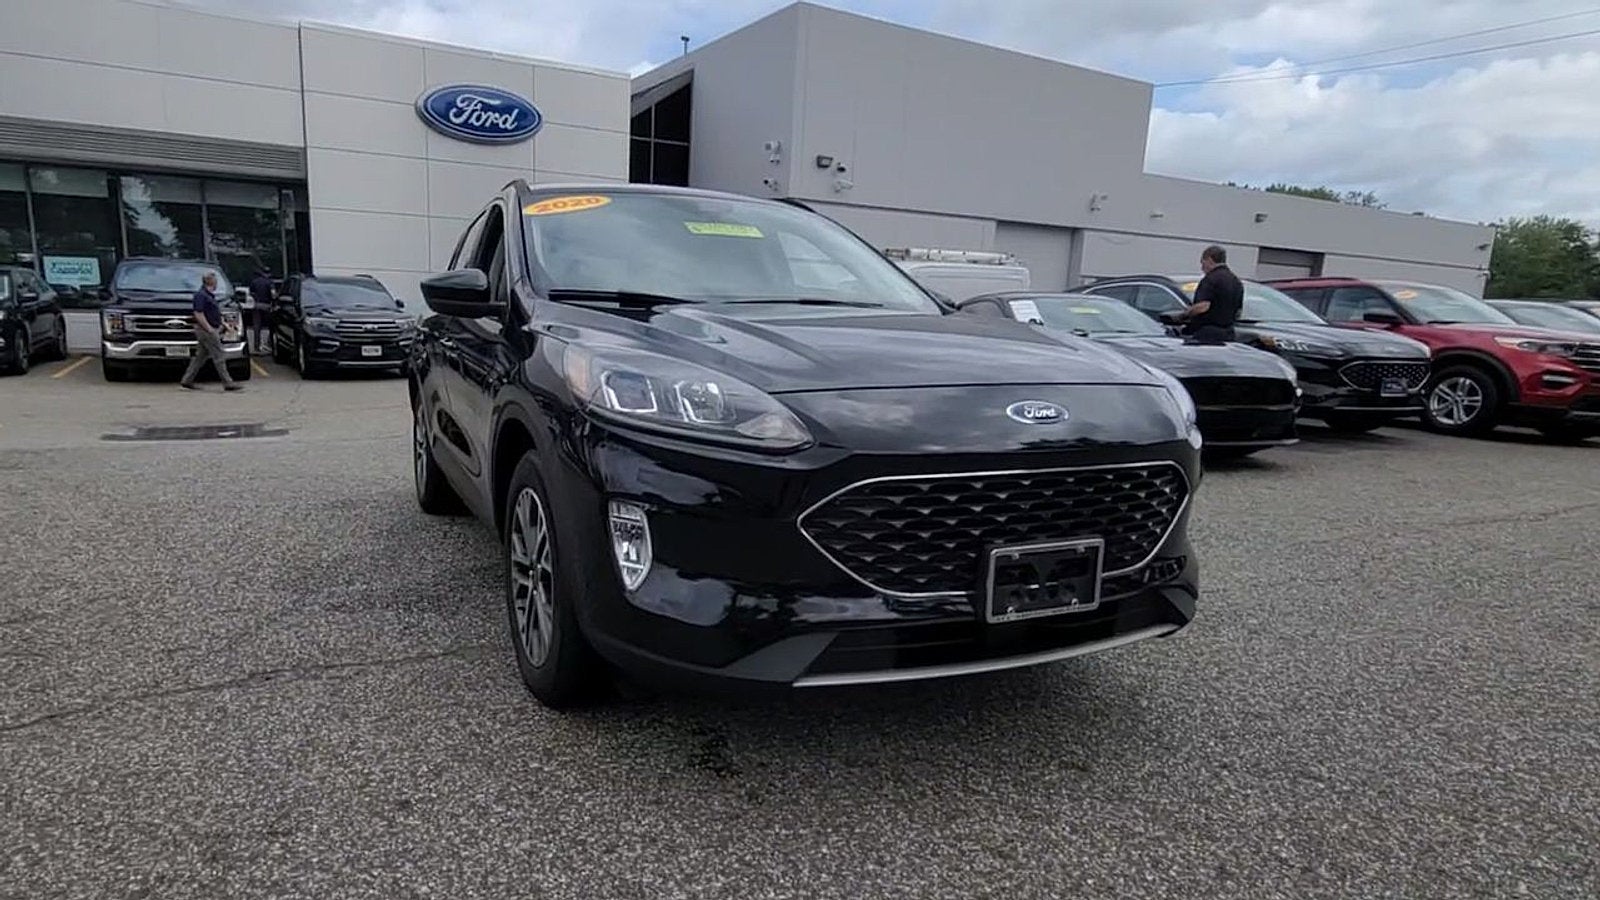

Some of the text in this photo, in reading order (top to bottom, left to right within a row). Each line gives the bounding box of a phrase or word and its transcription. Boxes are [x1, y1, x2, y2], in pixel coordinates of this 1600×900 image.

[449, 93, 519, 130] Ford
[533, 197, 600, 213] 2020
[1024, 404, 1058, 418] Ford
